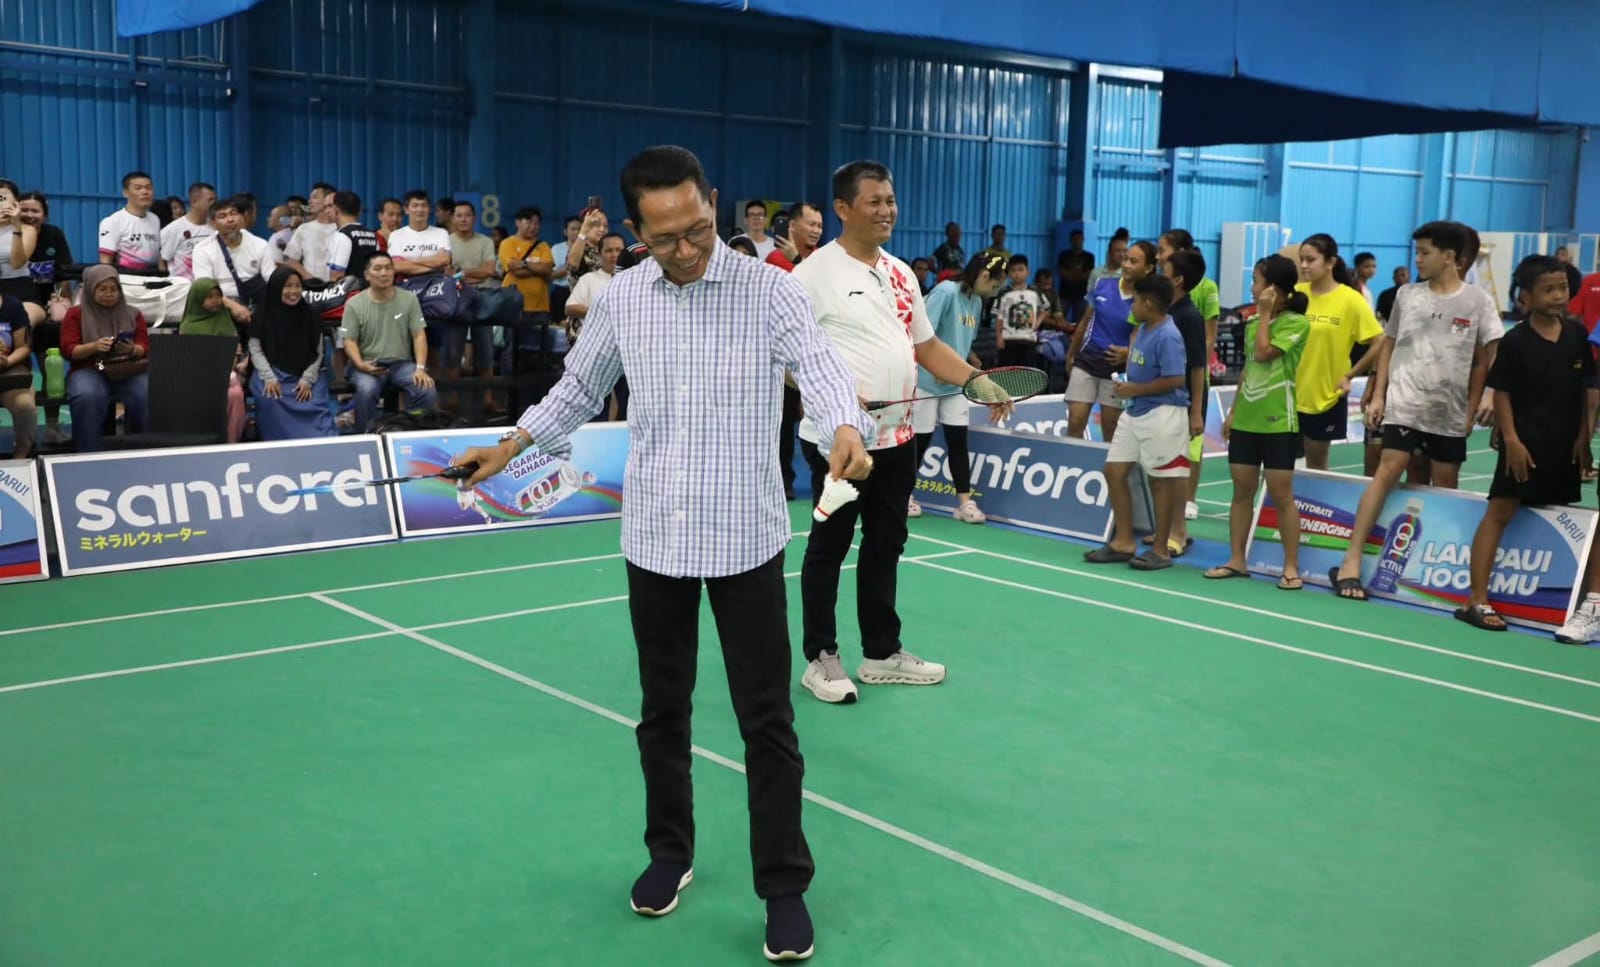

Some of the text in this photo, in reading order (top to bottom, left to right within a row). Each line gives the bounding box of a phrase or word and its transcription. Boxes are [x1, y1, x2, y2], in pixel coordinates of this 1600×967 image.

[482, 194, 500, 228] 8
[309, 282, 346, 304] YONEX
[513, 455, 556, 479] DAHAGA
[76, 454, 378, 532] sanford
[80, 527, 207, 551] ミネラルウォーター
